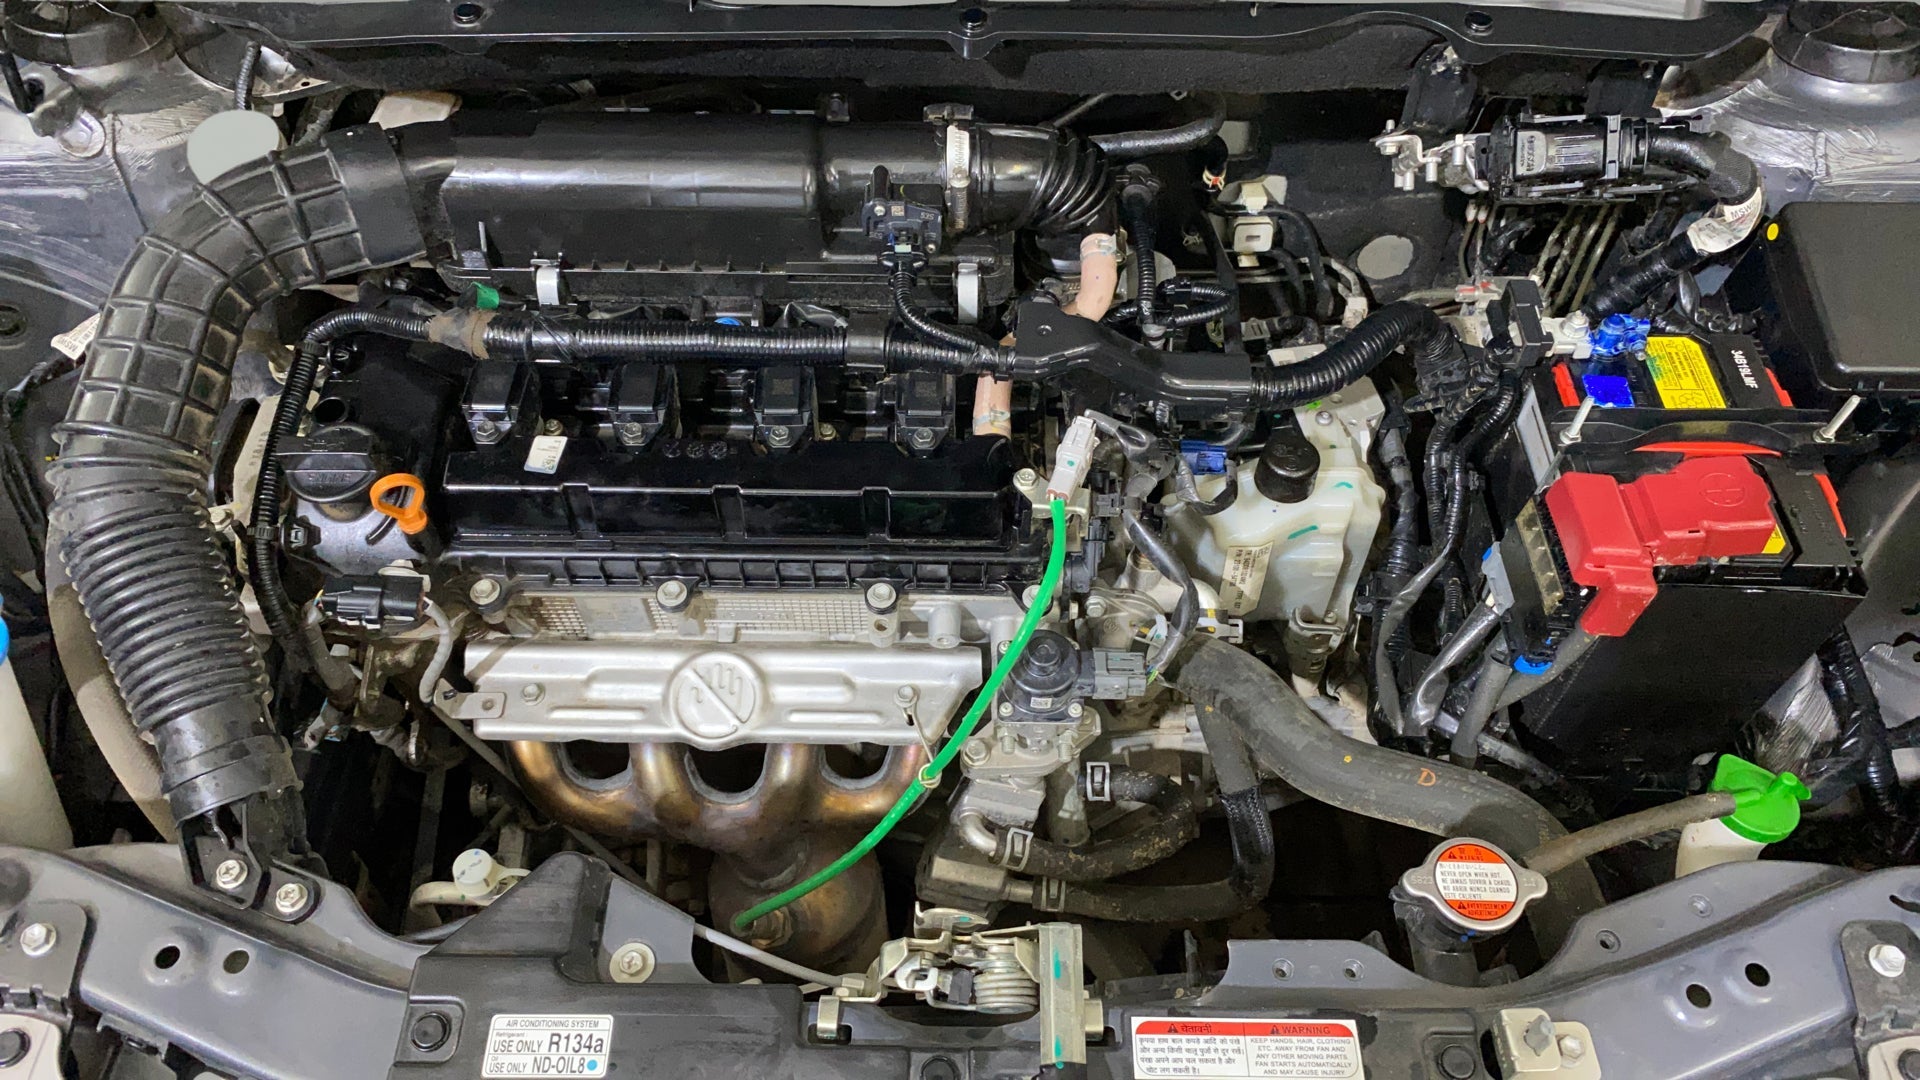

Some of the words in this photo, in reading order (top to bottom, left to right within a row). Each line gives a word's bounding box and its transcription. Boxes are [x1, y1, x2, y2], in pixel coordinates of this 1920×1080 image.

[1181, 1024, 1212, 1033] चेतावनी
[1282, 1026, 1330, 1034] WARNING
[493, 1040, 513, 1052] USE
[516, 1040, 543, 1052] ONLY
[548, 1033, 603, 1053] R134a
[489, 1063, 505, 1073] USE
[507, 1063, 527, 1073] ONLY
[532, 1057, 585, 1073] ND-OIL8
